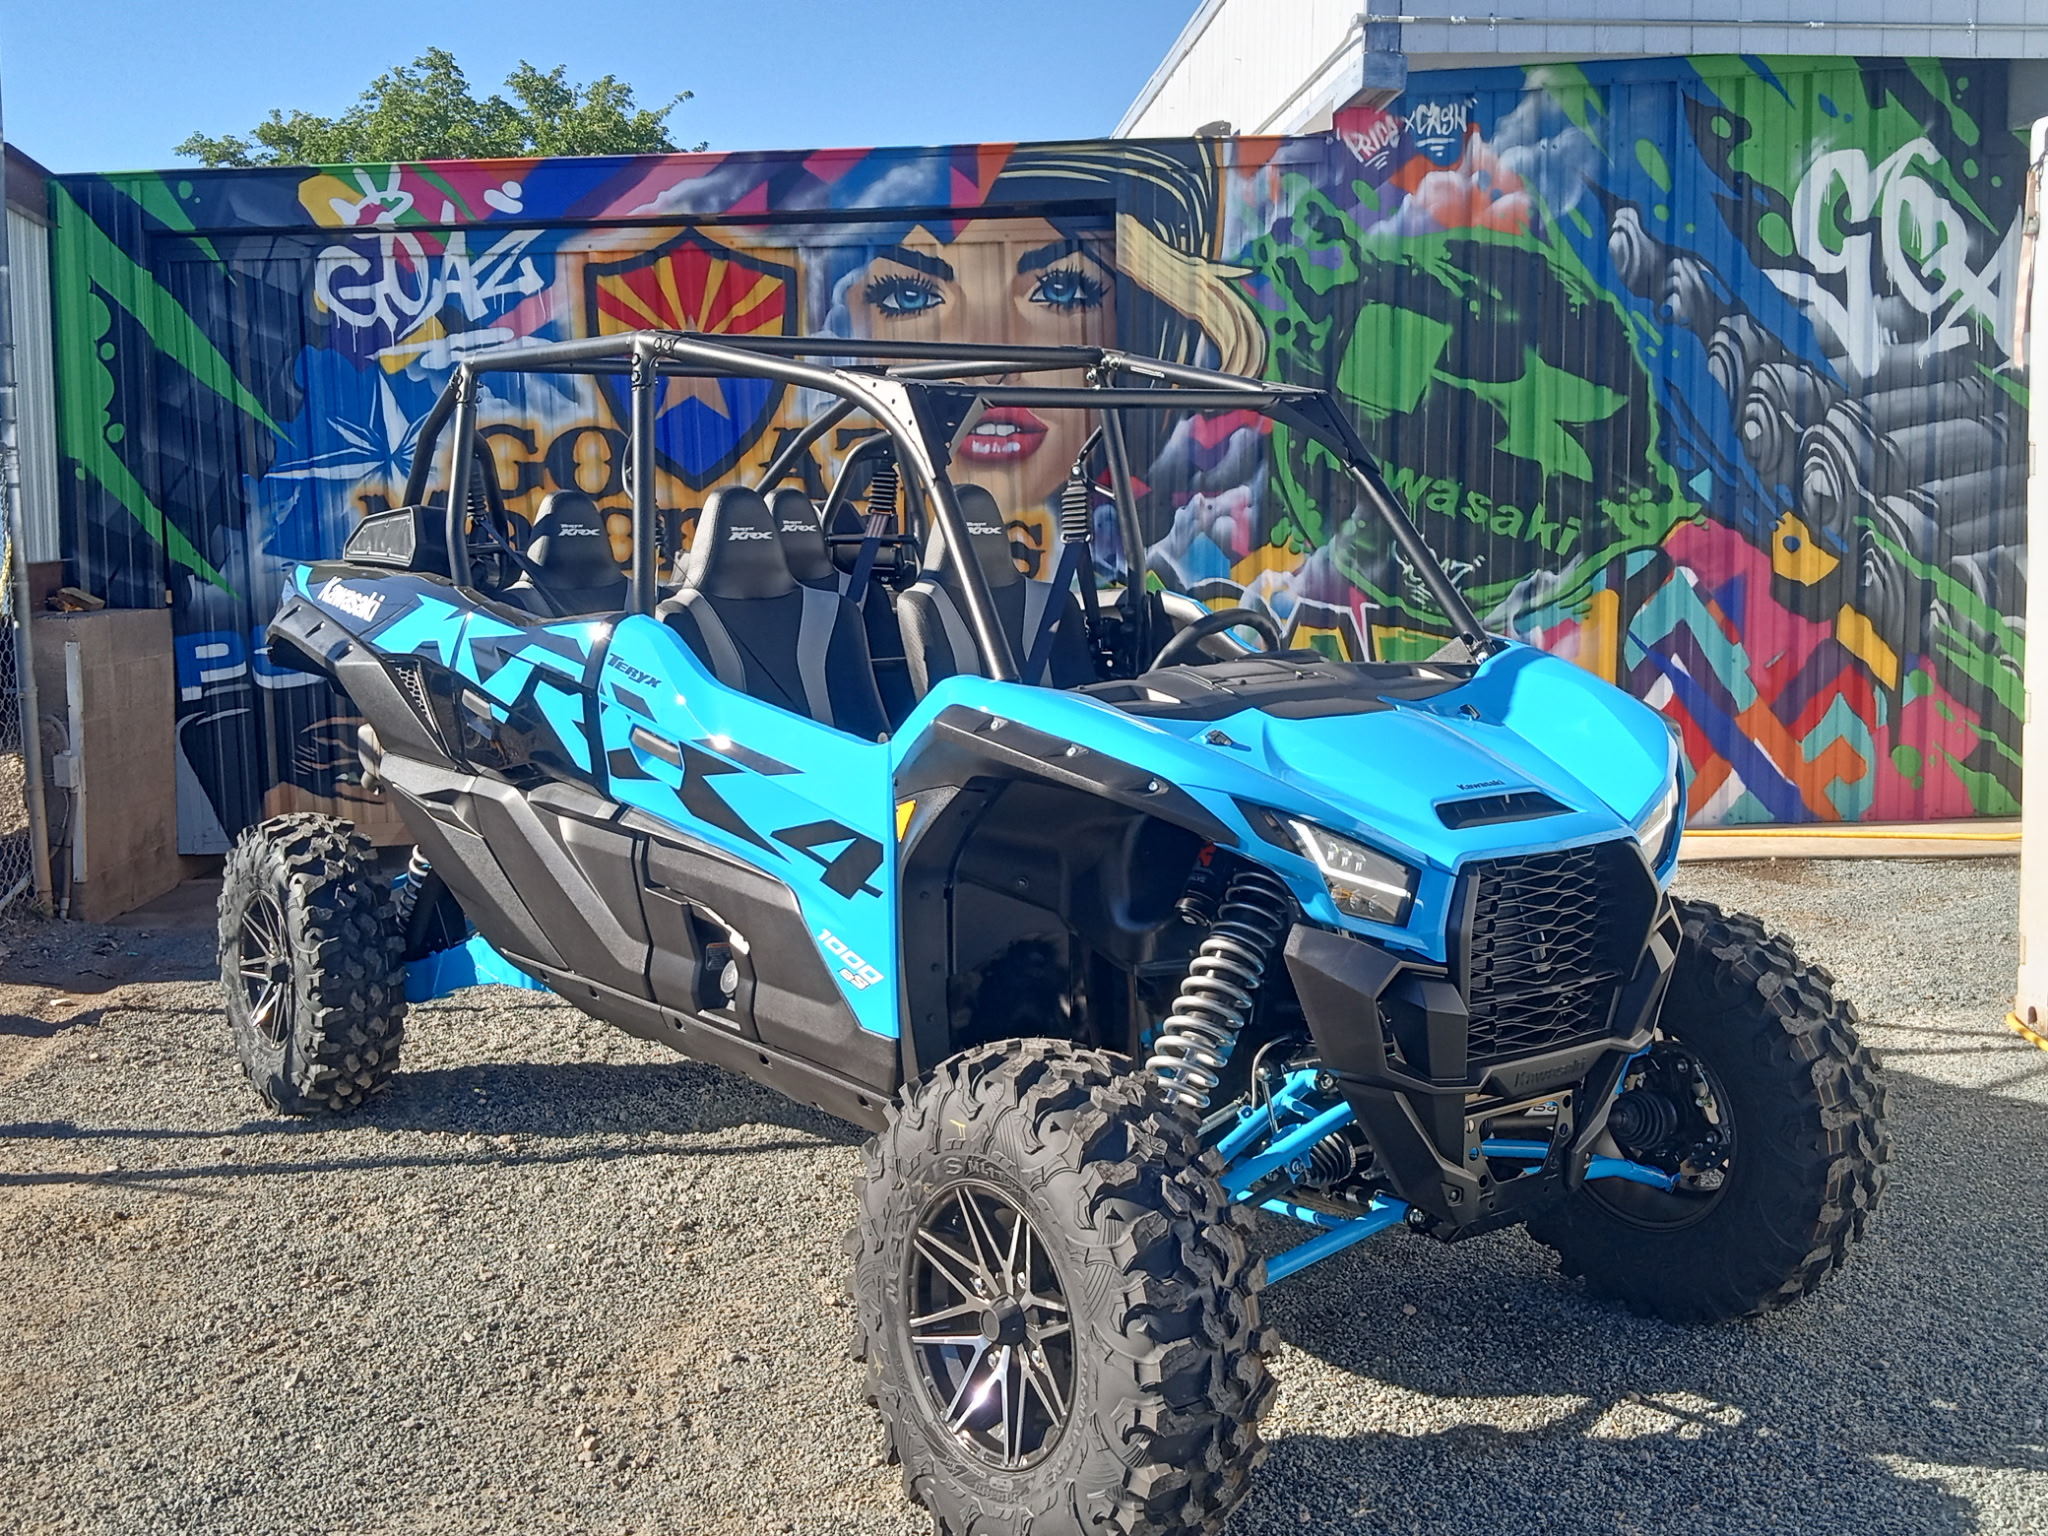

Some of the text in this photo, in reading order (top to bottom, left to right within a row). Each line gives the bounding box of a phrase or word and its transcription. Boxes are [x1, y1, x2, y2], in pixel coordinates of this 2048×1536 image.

[558, 528, 601, 537] KRX
[728, 531, 773, 541] KRX
[316, 576, 386, 622] Kawasaki
[1456, 778, 1506, 791] Kawasaki
[817, 928, 885, 985] 1000
[1513, 1058, 1587, 1088] Kawasaki
